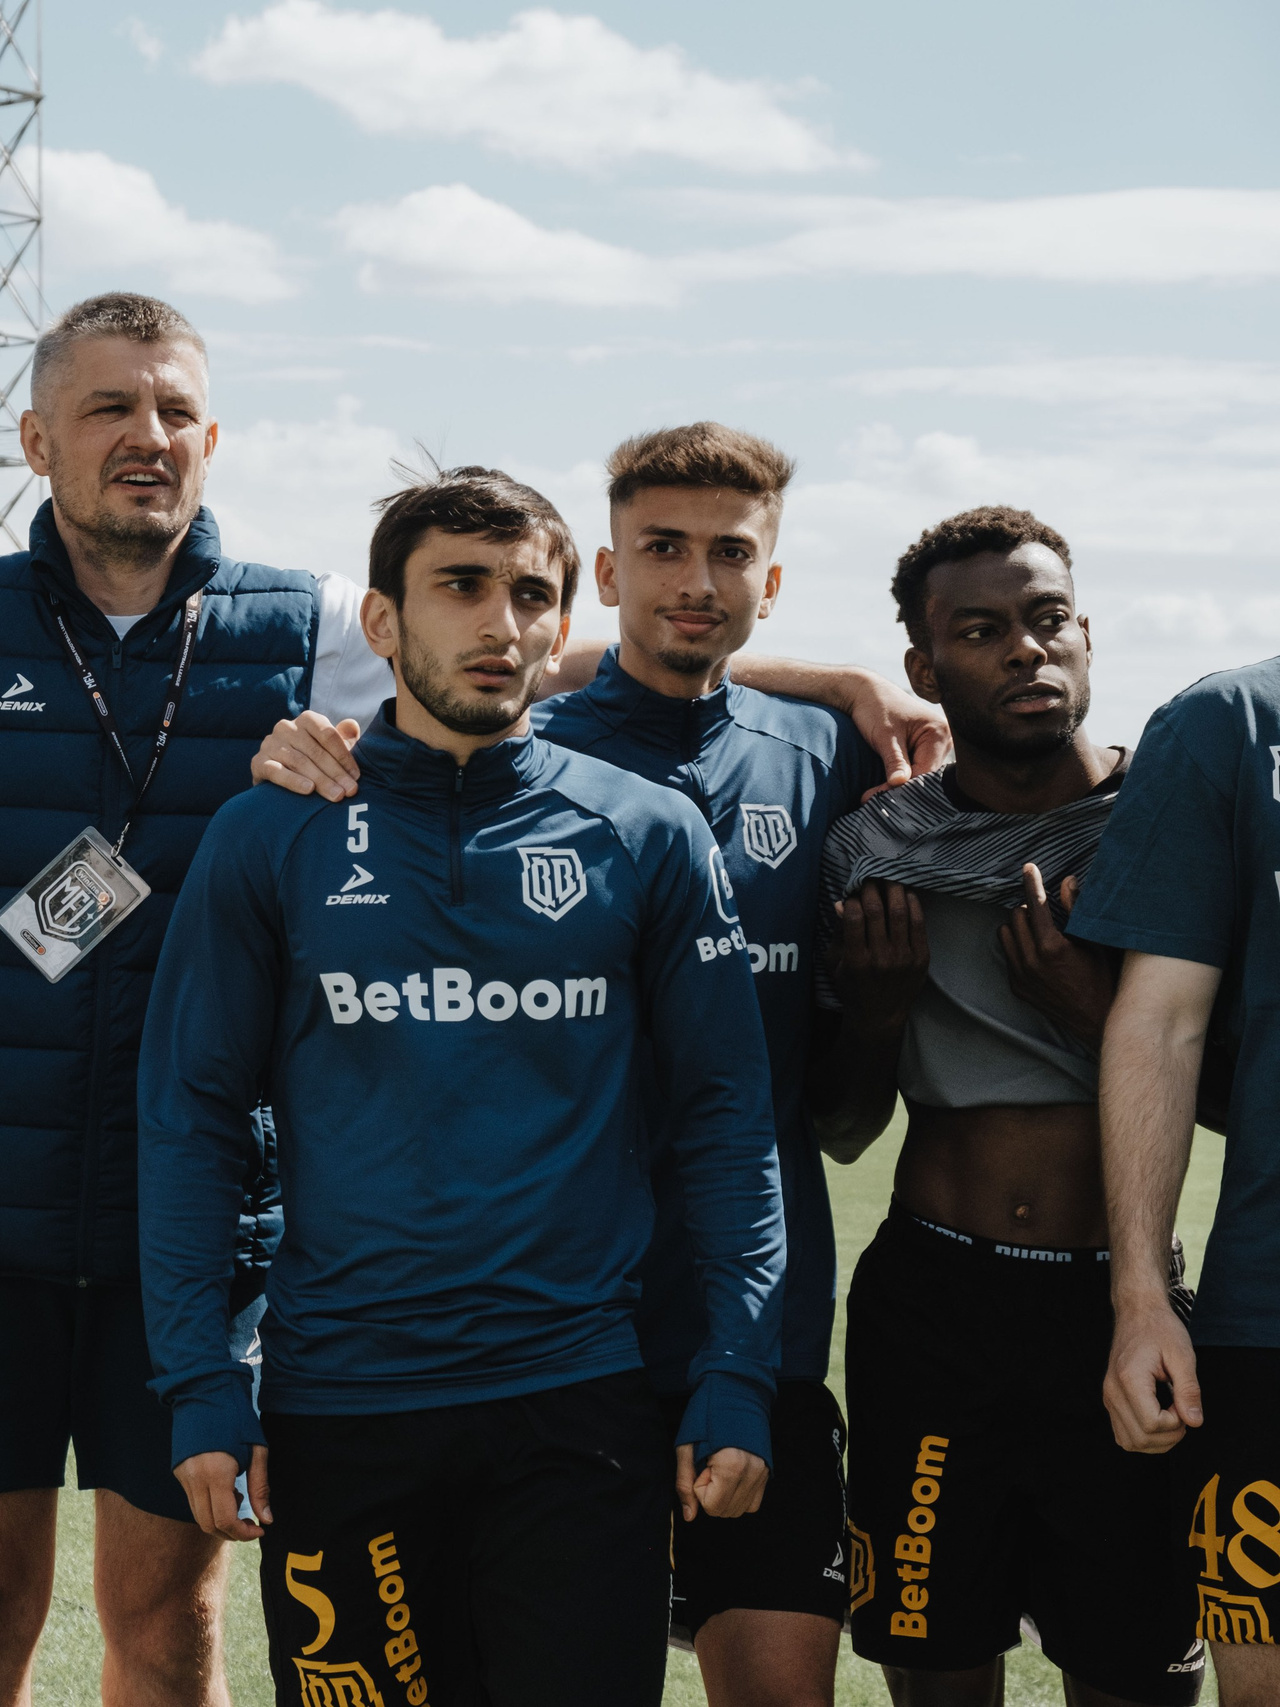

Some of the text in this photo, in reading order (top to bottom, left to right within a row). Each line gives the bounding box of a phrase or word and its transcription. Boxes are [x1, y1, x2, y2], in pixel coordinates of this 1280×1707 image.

[347, 803, 369, 854] 5
[326, 894, 391, 906] DEMIX
[720, 868, 734, 900] B
[320, 967, 608, 1025] BetBoom
[890, 1435, 950, 1639] BetBoom
[1188, 1473, 1280, 1589] 48
[285, 1550, 336, 1656] 5
[368, 1531, 431, 1707] etBoom
